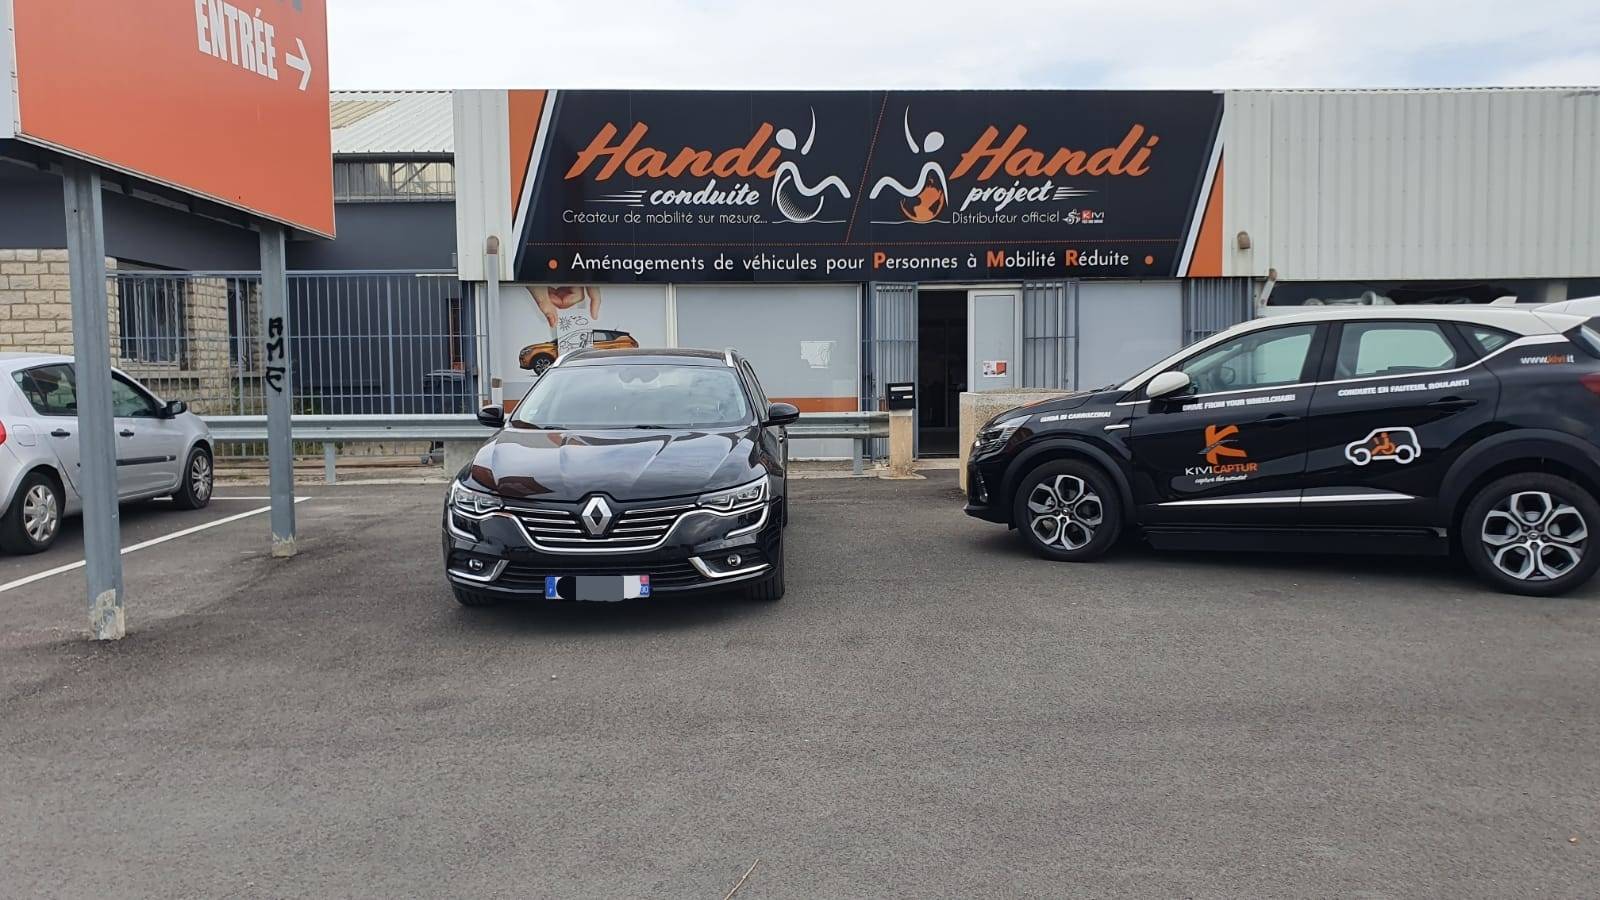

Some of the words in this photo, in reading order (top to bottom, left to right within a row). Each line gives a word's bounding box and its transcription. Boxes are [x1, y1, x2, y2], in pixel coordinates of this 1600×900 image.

[195, 0, 278, 80] ENTRÉE
[564, 121, 782, 181] Handi
[949, 124, 1159, 181] Handi
[650, 179, 760, 206] conduite
[960, 180, 1055, 211] project
[562, 210, 619, 223] Créateur
[623, 210, 641, 223] de
[646, 210, 693, 223] mobilité
[698, 213, 715, 223] sur
[719, 213, 768, 223] mesure...
[952, 210, 1018, 224] Distributeur
[1022, 210, 1060, 223] officiel
[571, 252, 705, 275] Aménagements
[714, 252, 734, 270] de
[743, 252, 817, 270] véhicules
[826, 256, 865, 274] pour
[873, 252, 958, 270] Personnes
[967, 253, 978, 269] à
[986, 250, 1056, 268] Mobilité
[1065, 249, 1129, 267] Réduite
